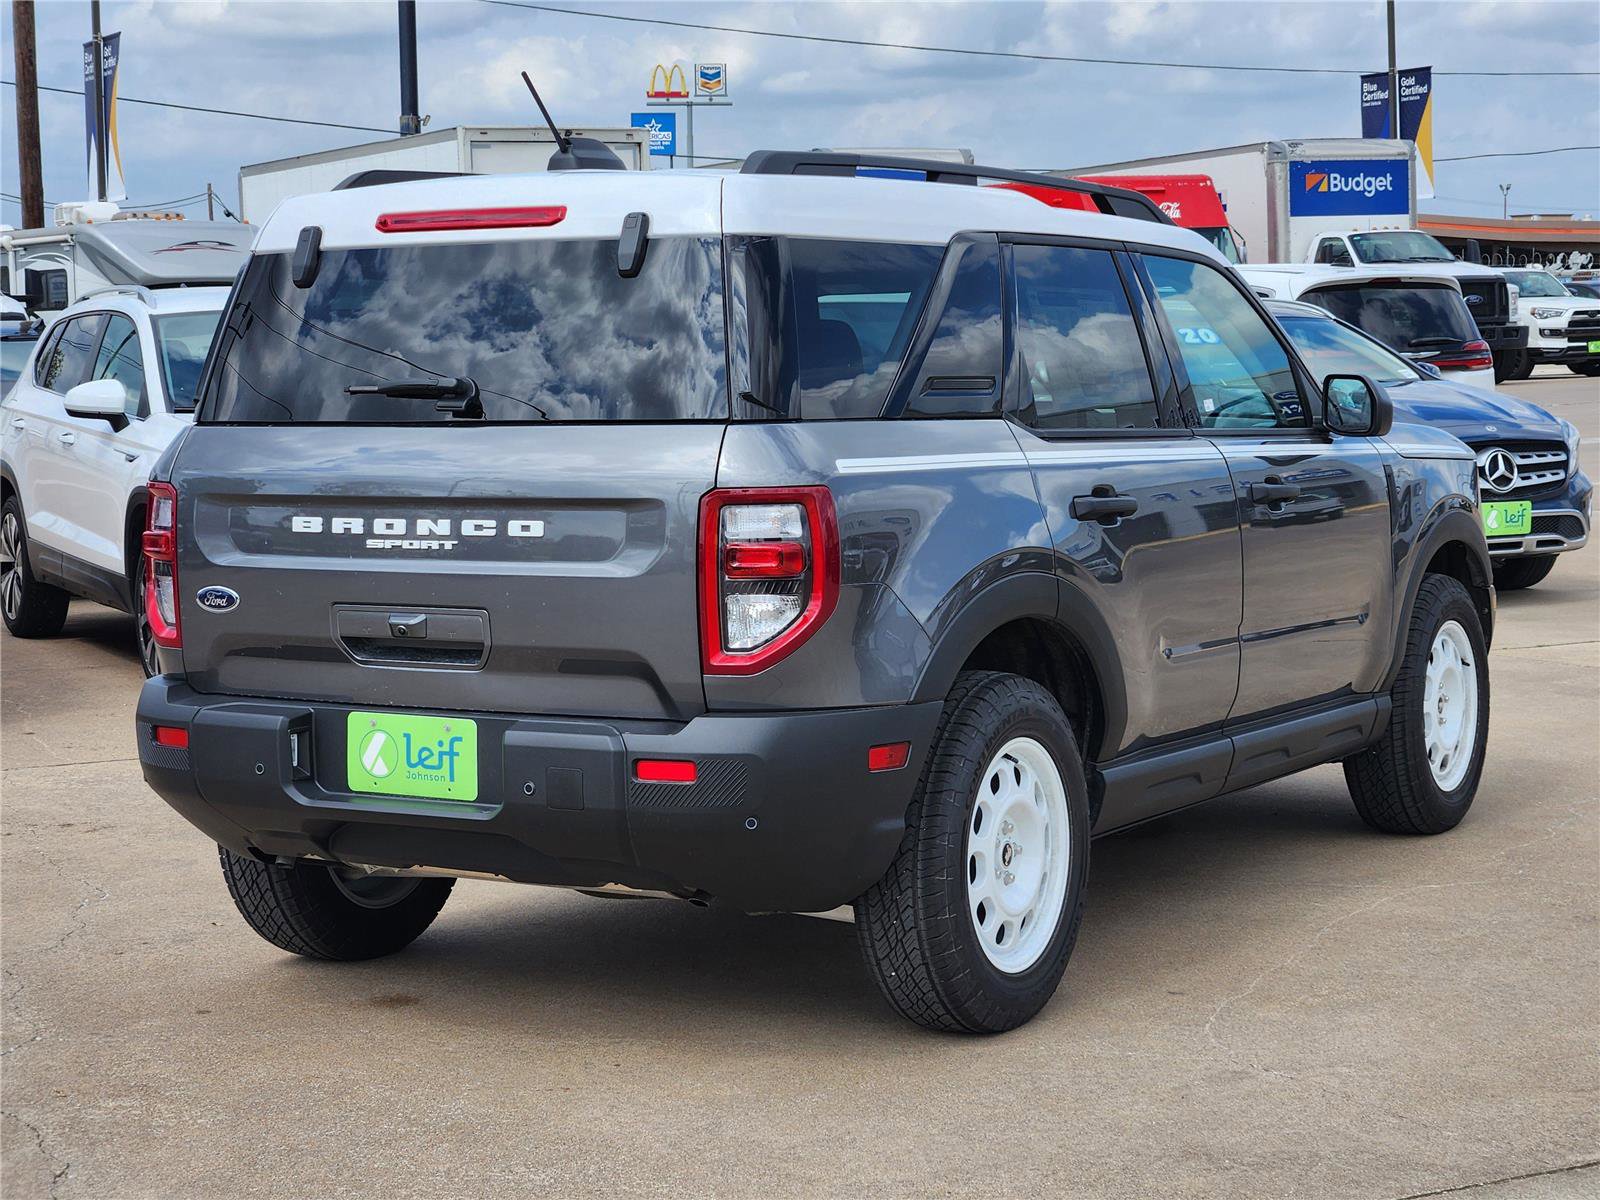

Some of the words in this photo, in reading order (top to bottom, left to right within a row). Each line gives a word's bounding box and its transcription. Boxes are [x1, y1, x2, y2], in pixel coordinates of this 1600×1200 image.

[1401, 76, 1415, 86] Gold
[1363, 83, 1377, 92] Blue
[1401, 84, 1428, 96] Certified
[1363, 89, 1389, 101] Certified
[1330, 173, 1393, 197] Budget
[292, 516, 545, 537] BRONCO
[366, 539, 458, 550] SPORT
[204, 590, 228, 607] Ford
[403, 732, 463, 782] leif
[406, 771, 446, 783] Johnson
